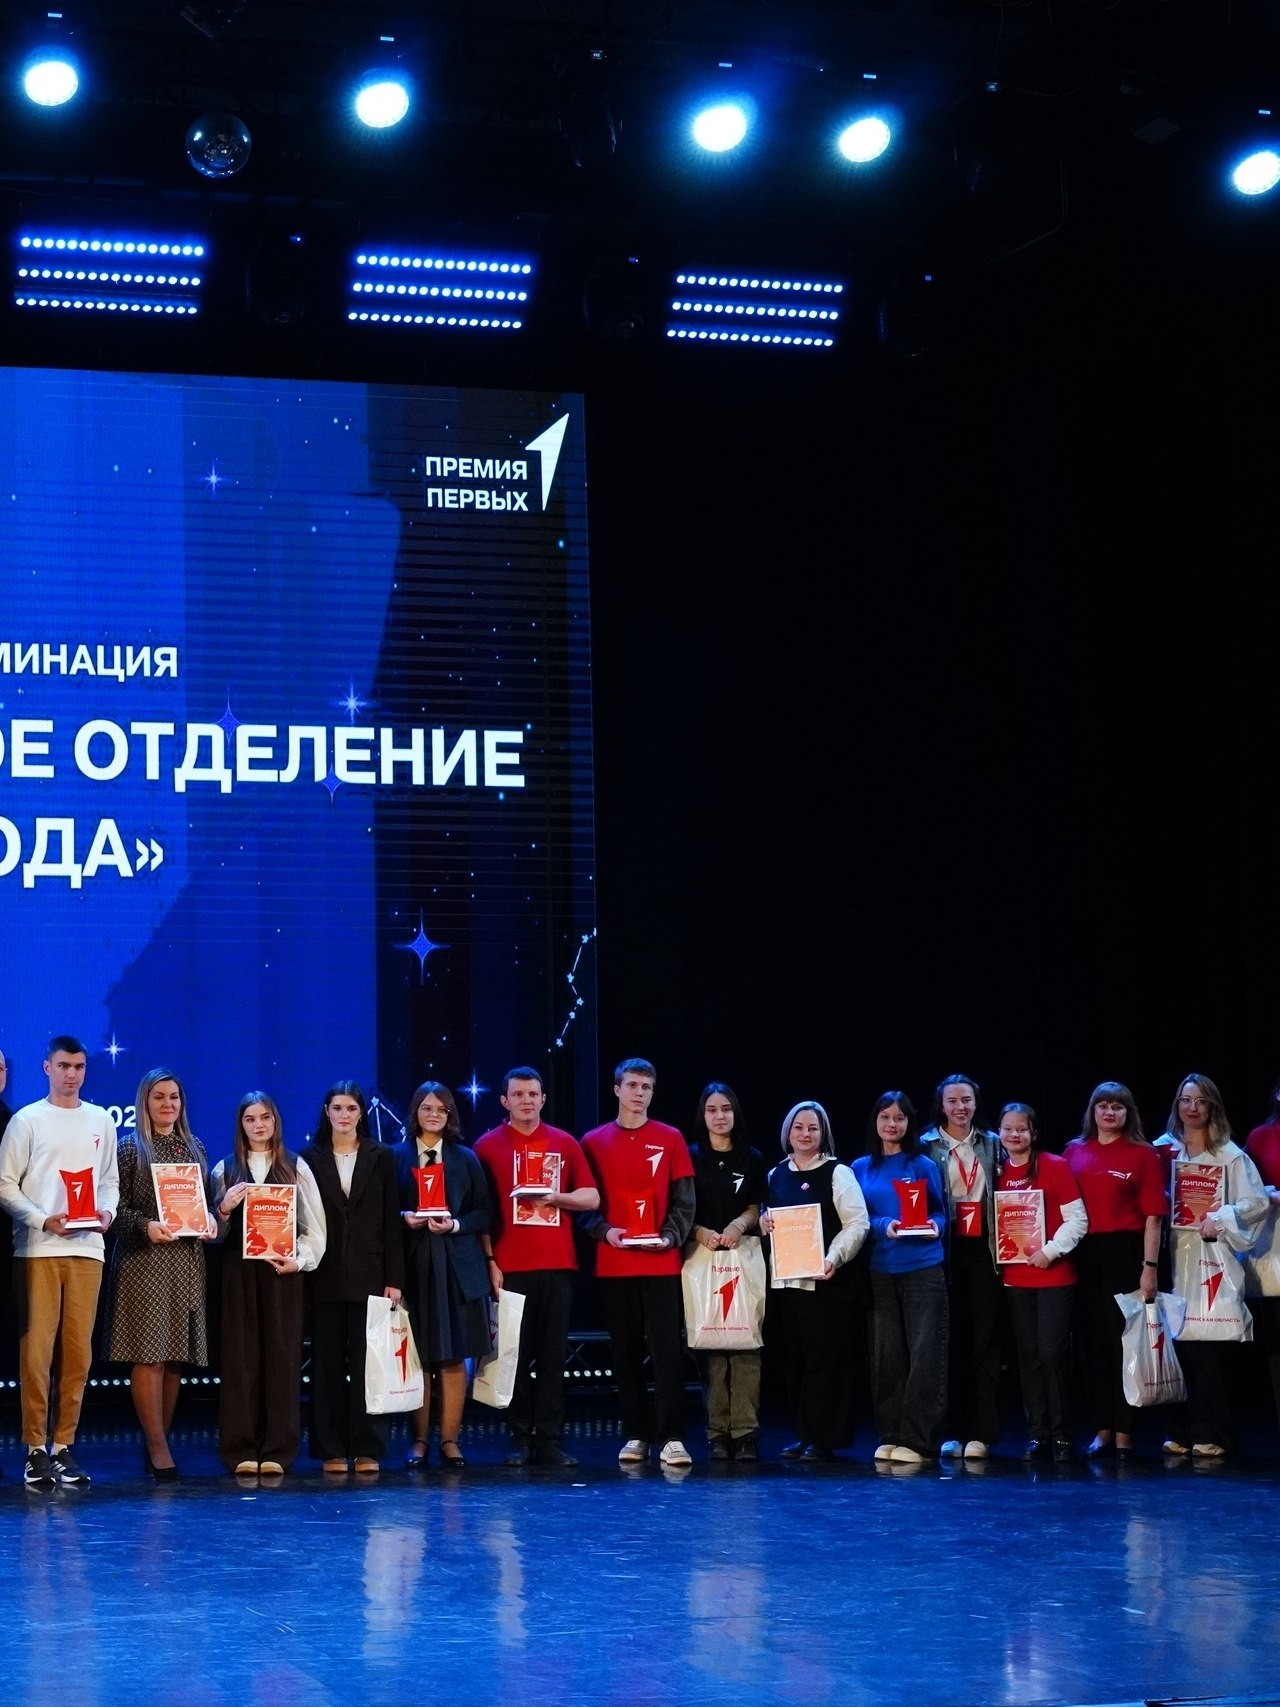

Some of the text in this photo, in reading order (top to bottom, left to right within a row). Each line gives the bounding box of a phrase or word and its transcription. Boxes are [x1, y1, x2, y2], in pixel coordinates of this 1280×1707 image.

[426, 456, 528, 480] ПРЕМИЯ
[427, 488, 529, 512] ПЕРВЫХ
[74, 720, 526, 794] ОТДЕЛЕНИЕ
[107, 1105, 136, 1127] 02
[1181, 1179, 1216, 1189] ДИПЛОМ
[253, 1204, 290, 1212] ДИПЛОМ
[1004, 1210, 1035, 1218] ДИПЛОМ
